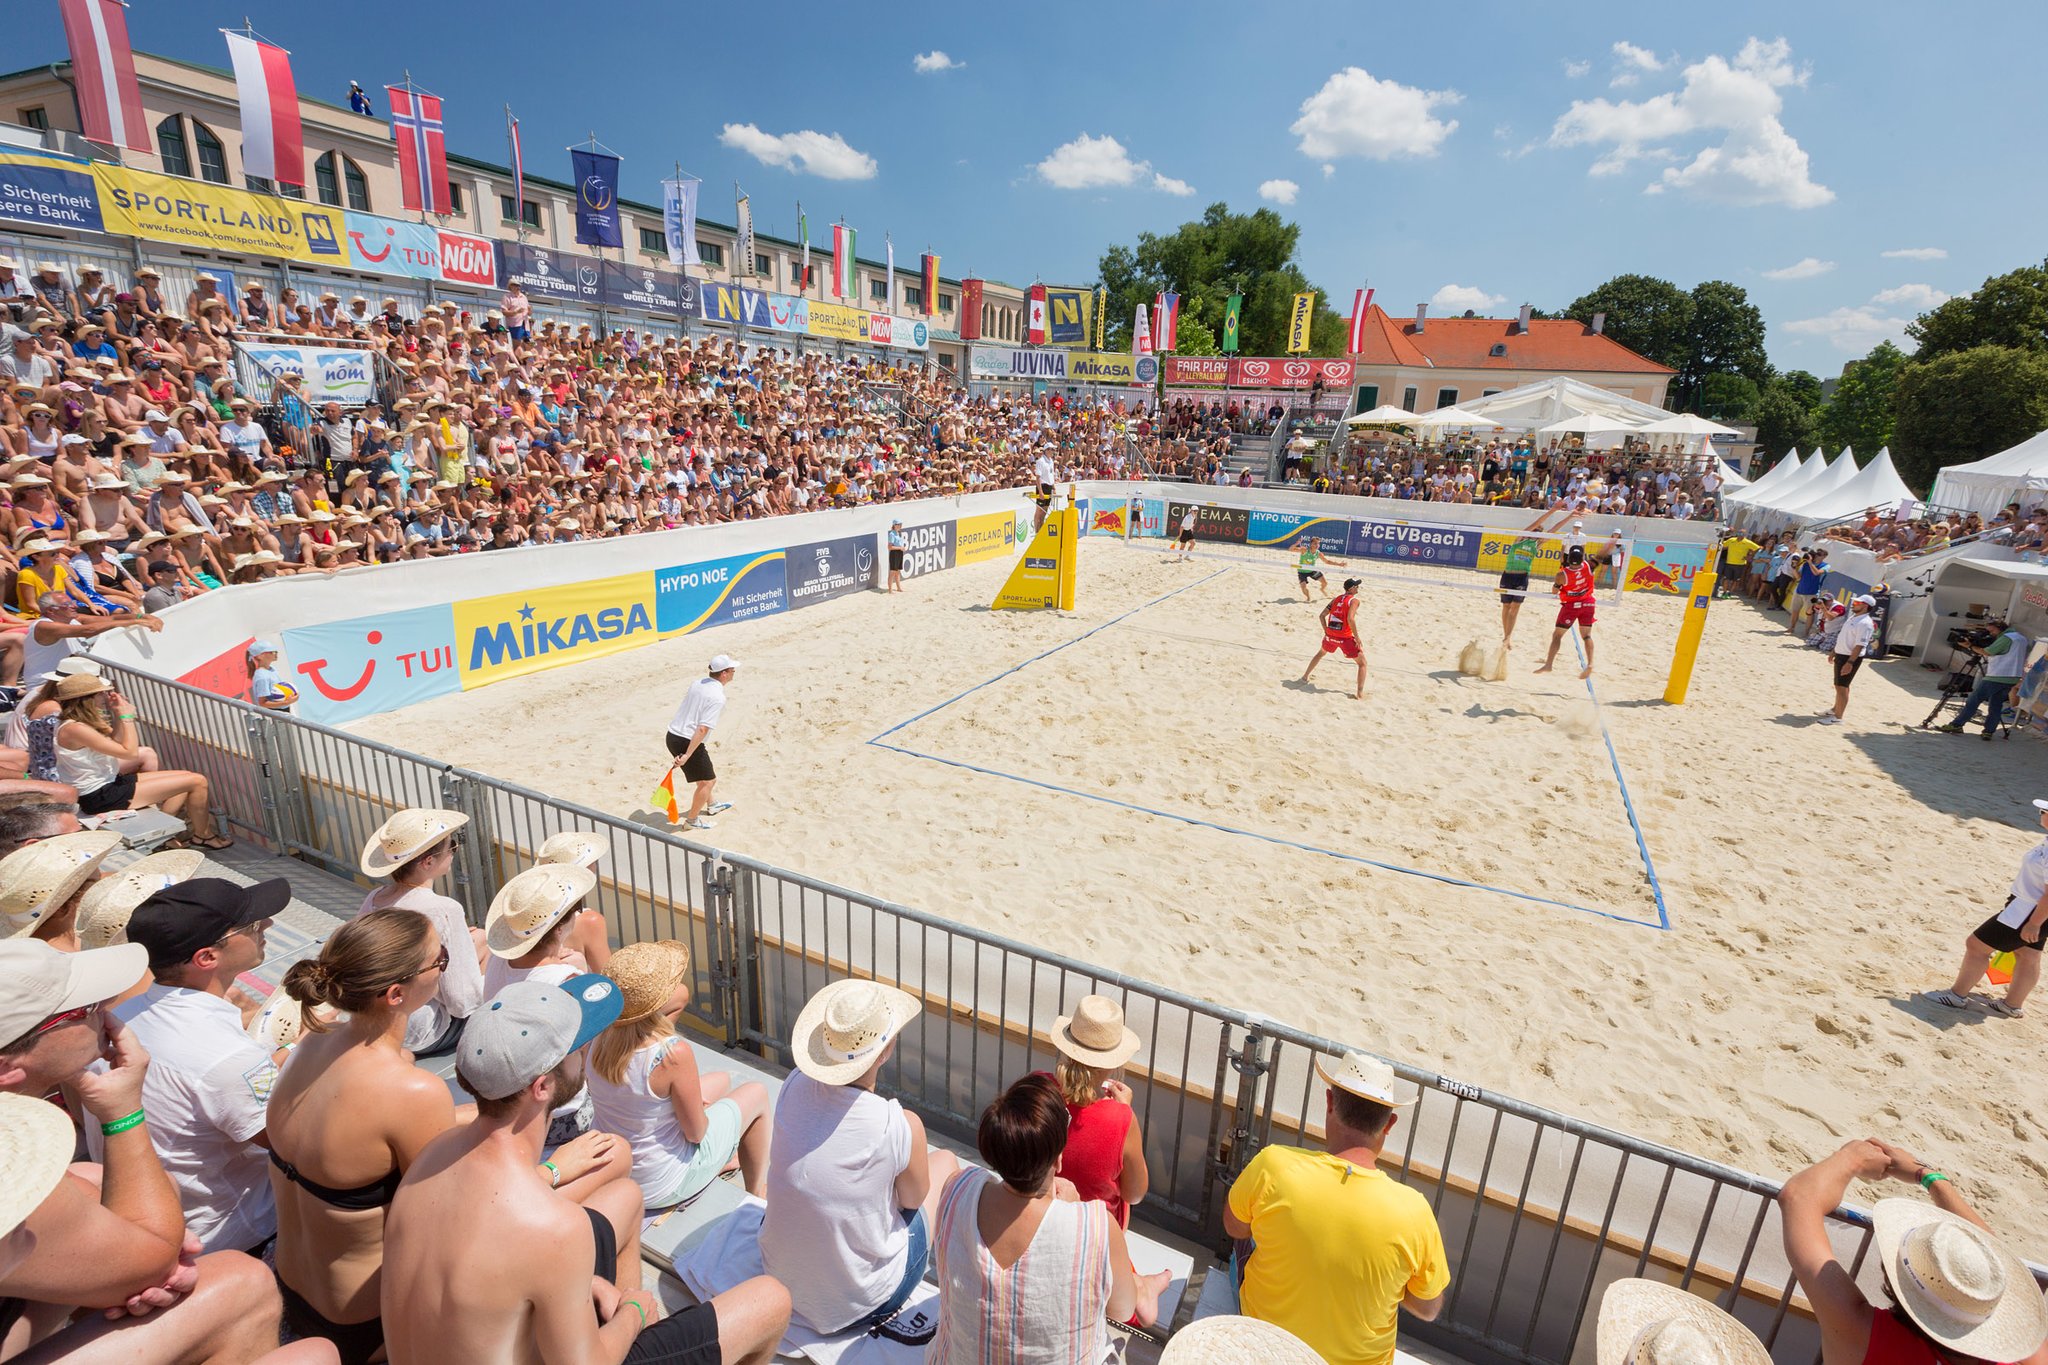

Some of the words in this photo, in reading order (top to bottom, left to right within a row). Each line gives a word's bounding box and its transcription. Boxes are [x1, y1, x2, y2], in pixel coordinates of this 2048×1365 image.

[3, 184, 92, 209] Sicherheit
[38, 205, 85, 222] Bank.
[112, 188, 298, 237] SPORT.LAND.
[402, 247, 436, 267] TUI
[443, 241, 491, 277] NÖN
[549, 282, 577, 292] TOUR
[582, 287, 598, 295] CEV
[623, 293, 654, 304] WORLD
[655, 299, 677, 307] TOUR
[681, 302, 694, 310] CEV
[793, 314, 808, 325] TUI
[871, 317, 891, 339] NÖN
[975, 355, 1009, 369] Baden
[1009, 352, 1065, 376] JUVINA
[1177, 360, 1200, 372] FAIR
[1203, 361, 1228, 373] PLAY
[1214, 373, 1227, 381] WAY
[1242, 377, 1269, 385] ESKIMO
[1282, 378, 1309, 386] ESKIMO
[1252, 512, 1279, 522] HYPO
[1281, 515, 1301, 524] NOE
[901, 524, 946, 551] BADEN
[958, 529, 1003, 546] SPORT.LAND.
[1170, 521, 1245, 537] PADISO
[1361, 522, 1465, 546] #CEVBeach
[816, 547, 830, 556] FIVB
[901, 546, 946, 578] OPEN
[660, 573, 699, 593] HYPO
[702, 568, 728, 586] NOE
[859, 572, 871, 582] CEV
[793, 582, 828, 597] WORLD
[830, 577, 854, 588] TOUR
[732, 597, 744, 608] Mit
[746, 588, 783, 604] Sicherheit
[732, 605, 758, 618] unsere
[760, 600, 780, 612] Bank.
[396, 645, 452, 678] TUI
